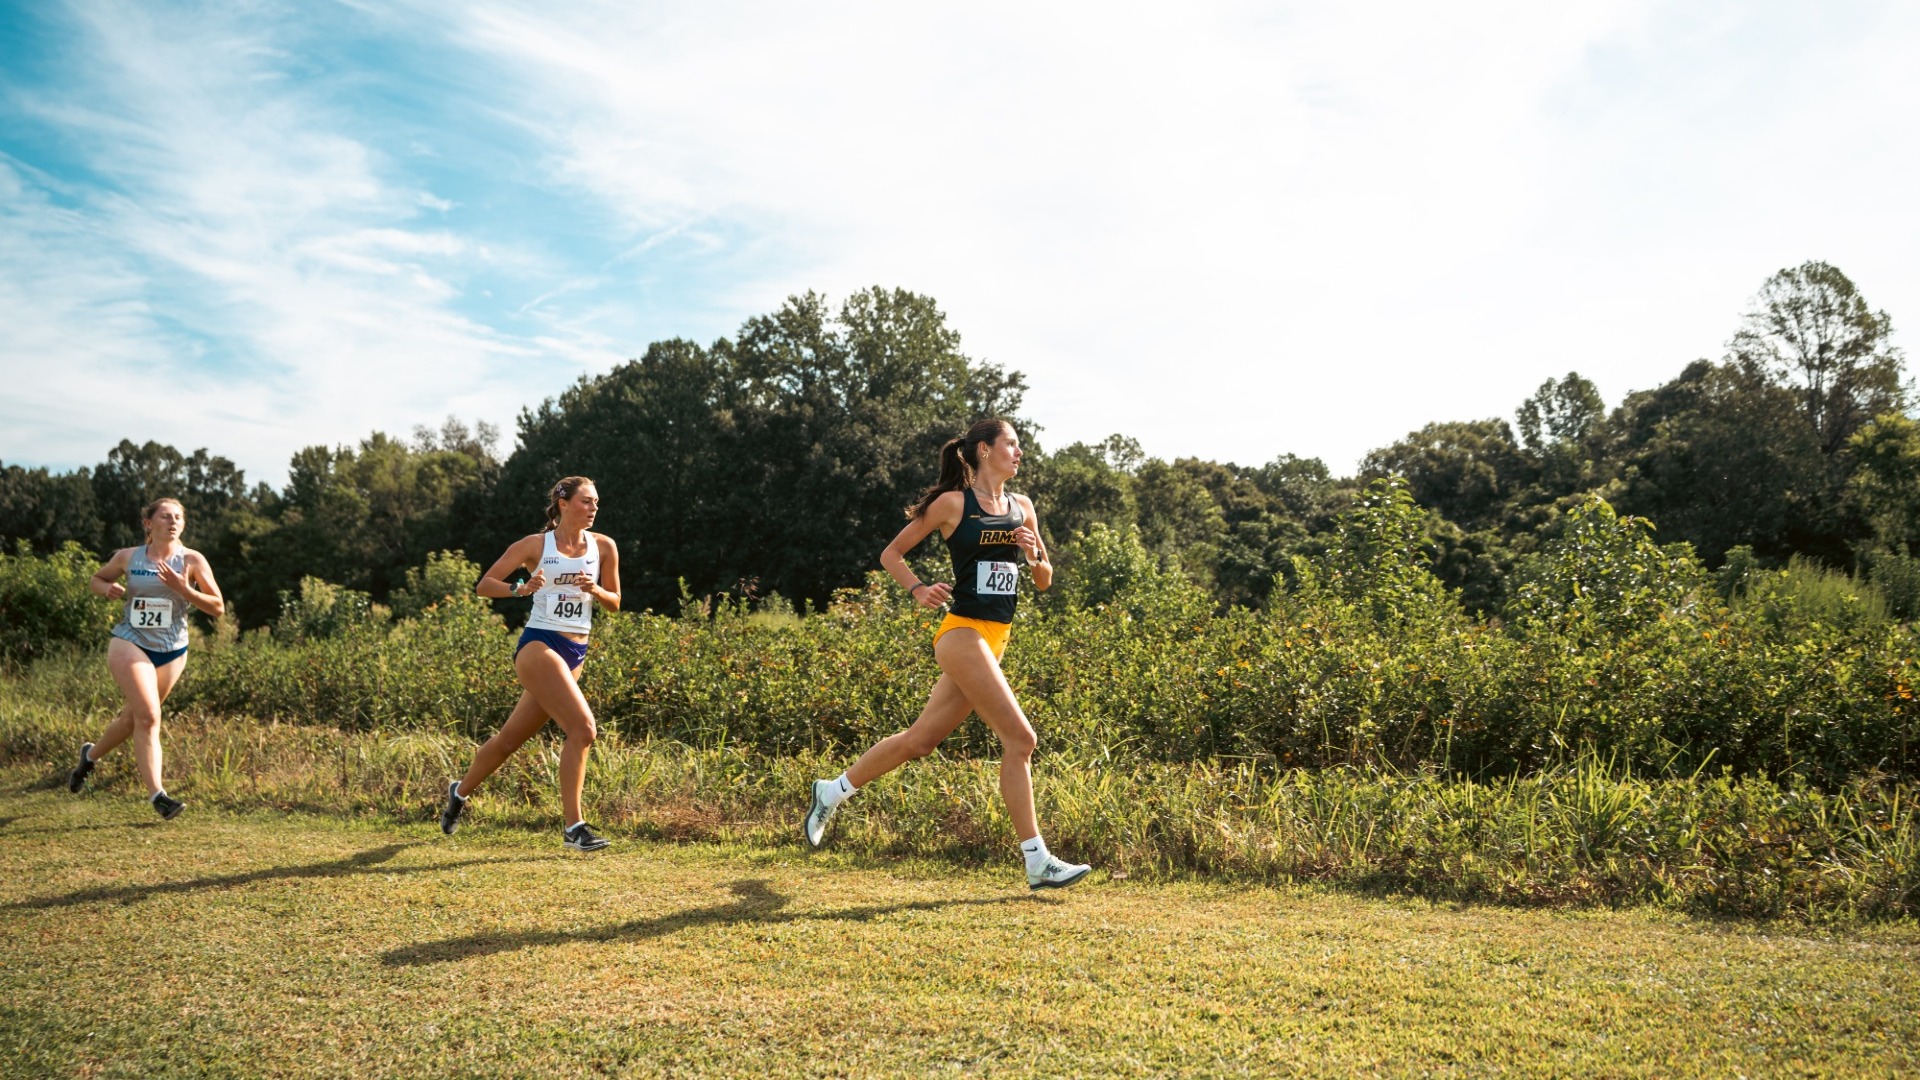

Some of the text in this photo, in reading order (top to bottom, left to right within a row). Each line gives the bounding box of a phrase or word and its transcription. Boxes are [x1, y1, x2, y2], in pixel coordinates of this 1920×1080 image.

[554, 573, 592, 586] JM
[985, 571, 1014, 592] 428
[553, 602, 583, 618] 494
[139, 611, 162, 626] 324
